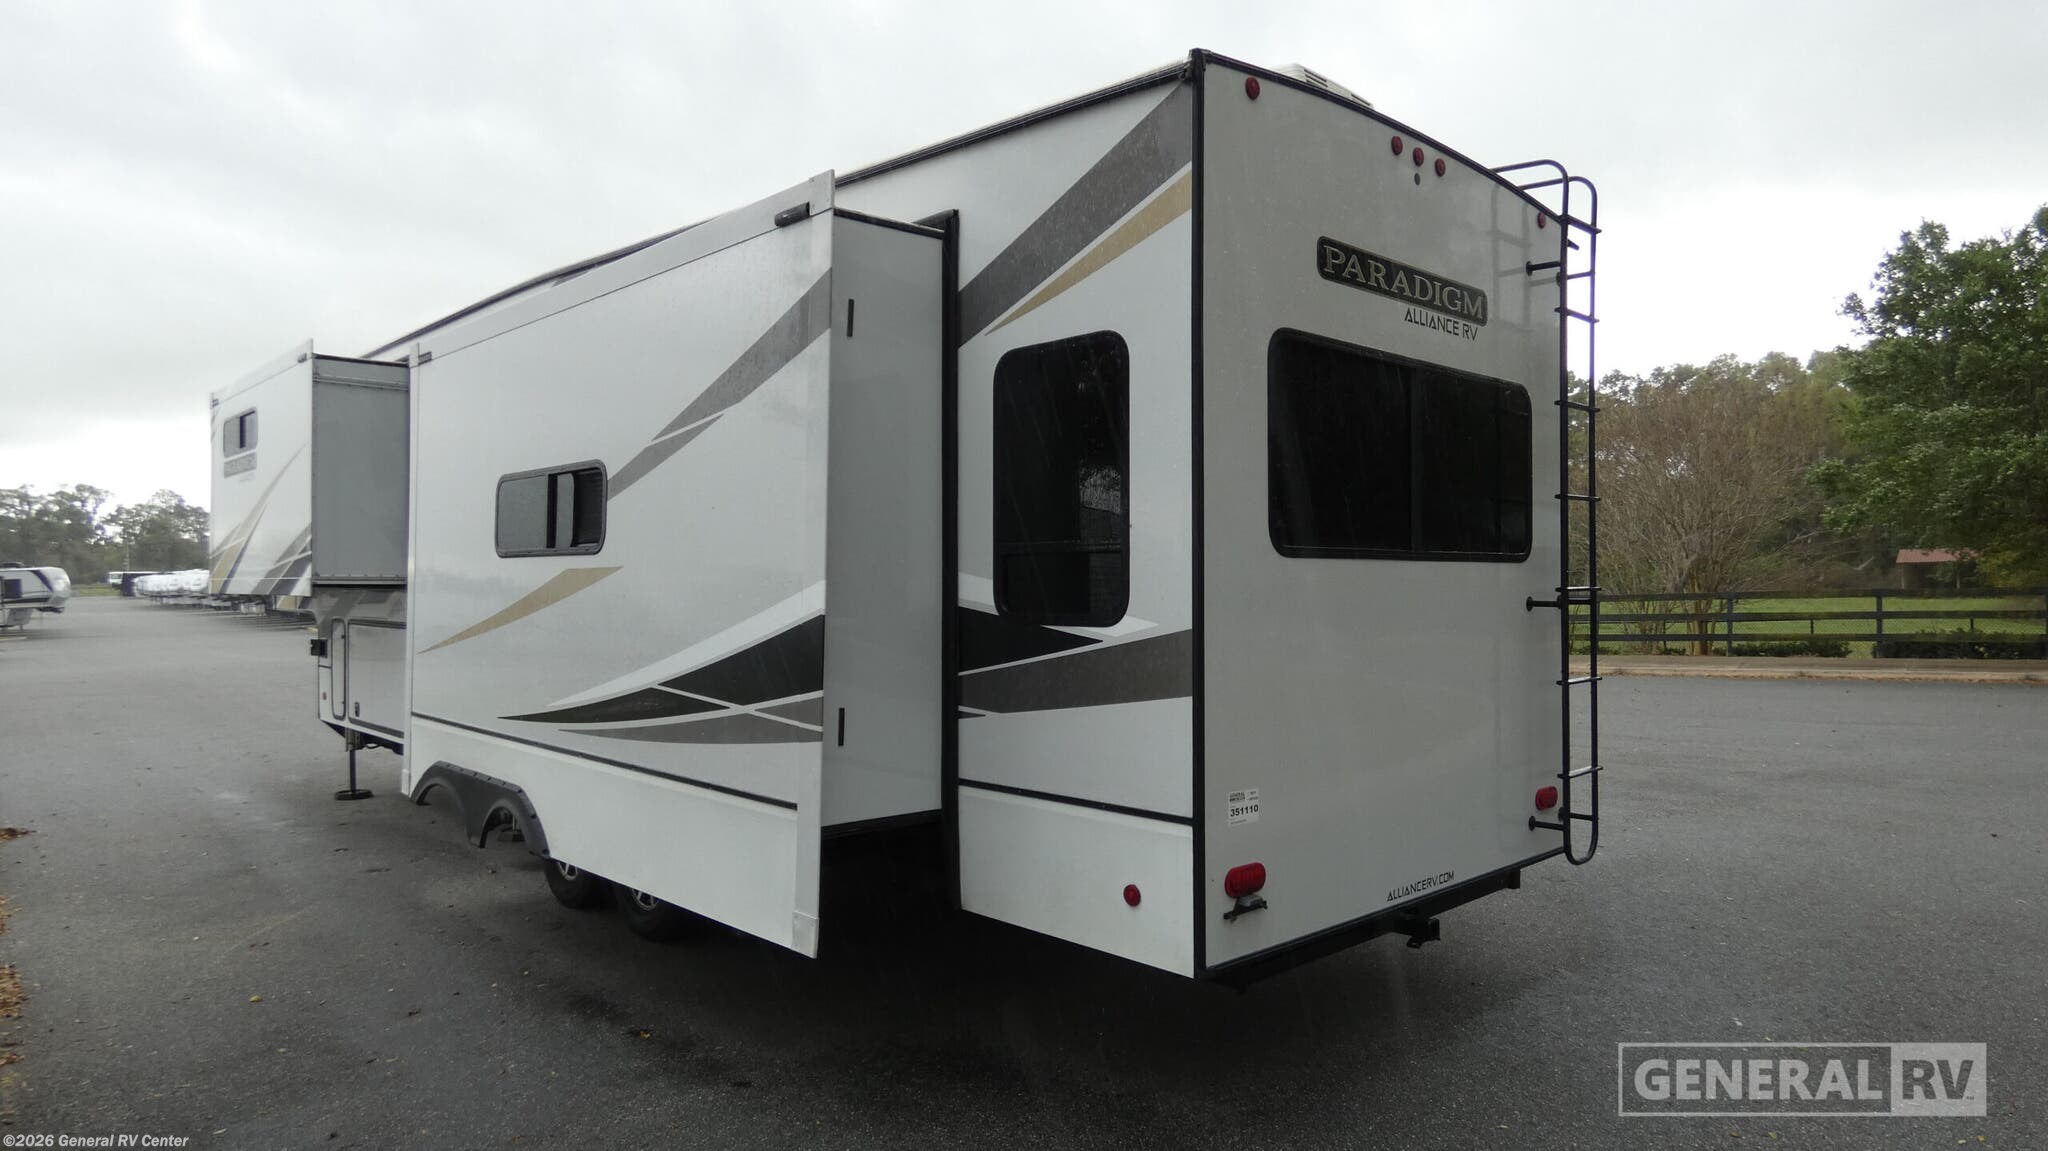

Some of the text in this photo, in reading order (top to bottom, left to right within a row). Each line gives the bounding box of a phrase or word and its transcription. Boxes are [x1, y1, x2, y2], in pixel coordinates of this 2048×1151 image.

[1322, 244, 1485, 320] PARADIGM
[1404, 306, 1479, 343] ALLIANCE RV
[1230, 804, 1259, 817] 351110
[1387, 870, 1455, 902] ALLIANCERV.COM
